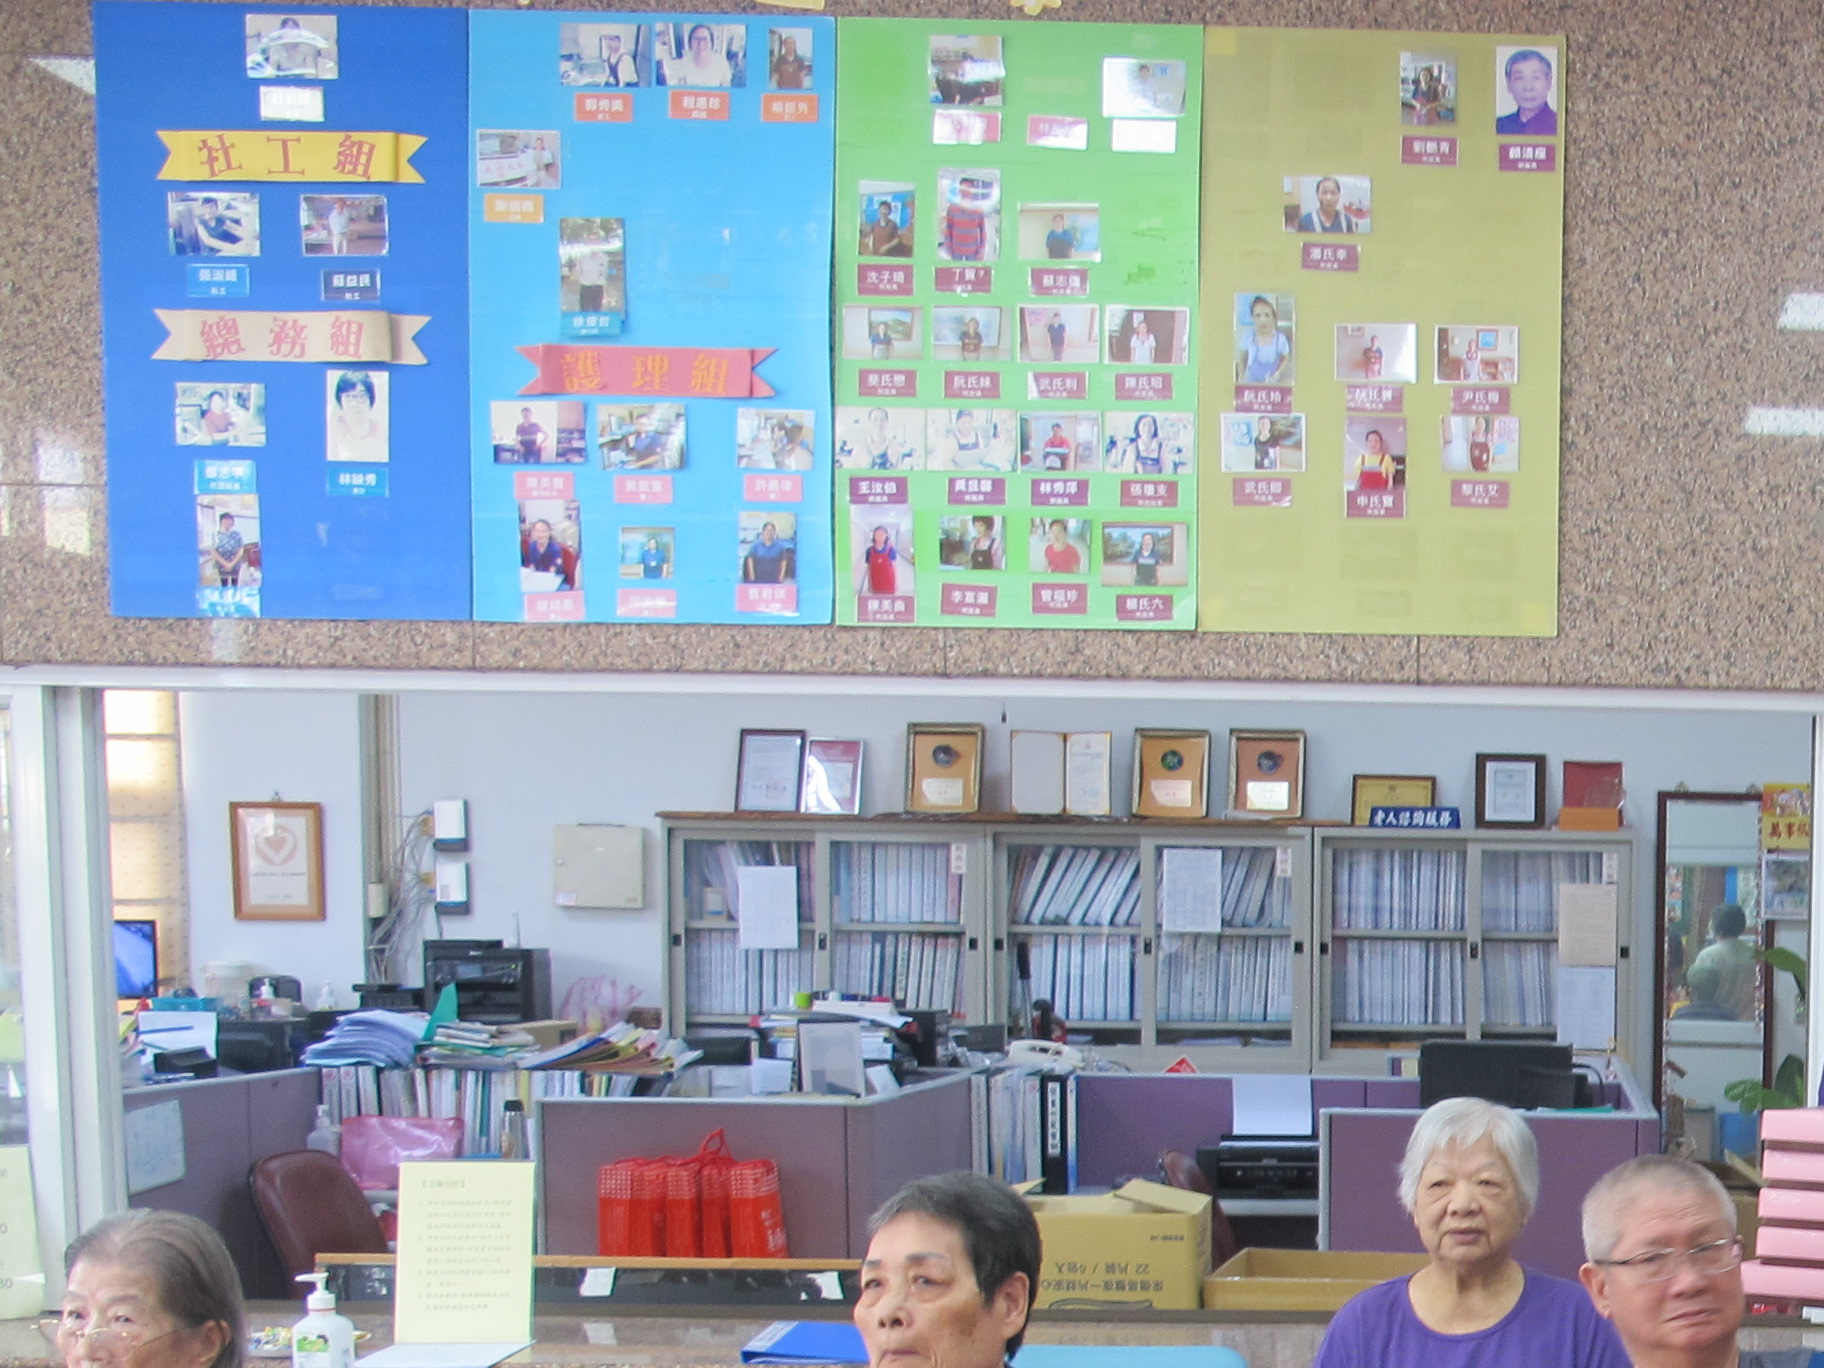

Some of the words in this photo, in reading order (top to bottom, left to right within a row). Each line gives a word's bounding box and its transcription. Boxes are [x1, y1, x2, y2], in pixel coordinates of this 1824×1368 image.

[198, 133, 376, 182] 社工組
[200, 316, 365, 359] 總務組
[561, 351, 729, 393] 護理組
